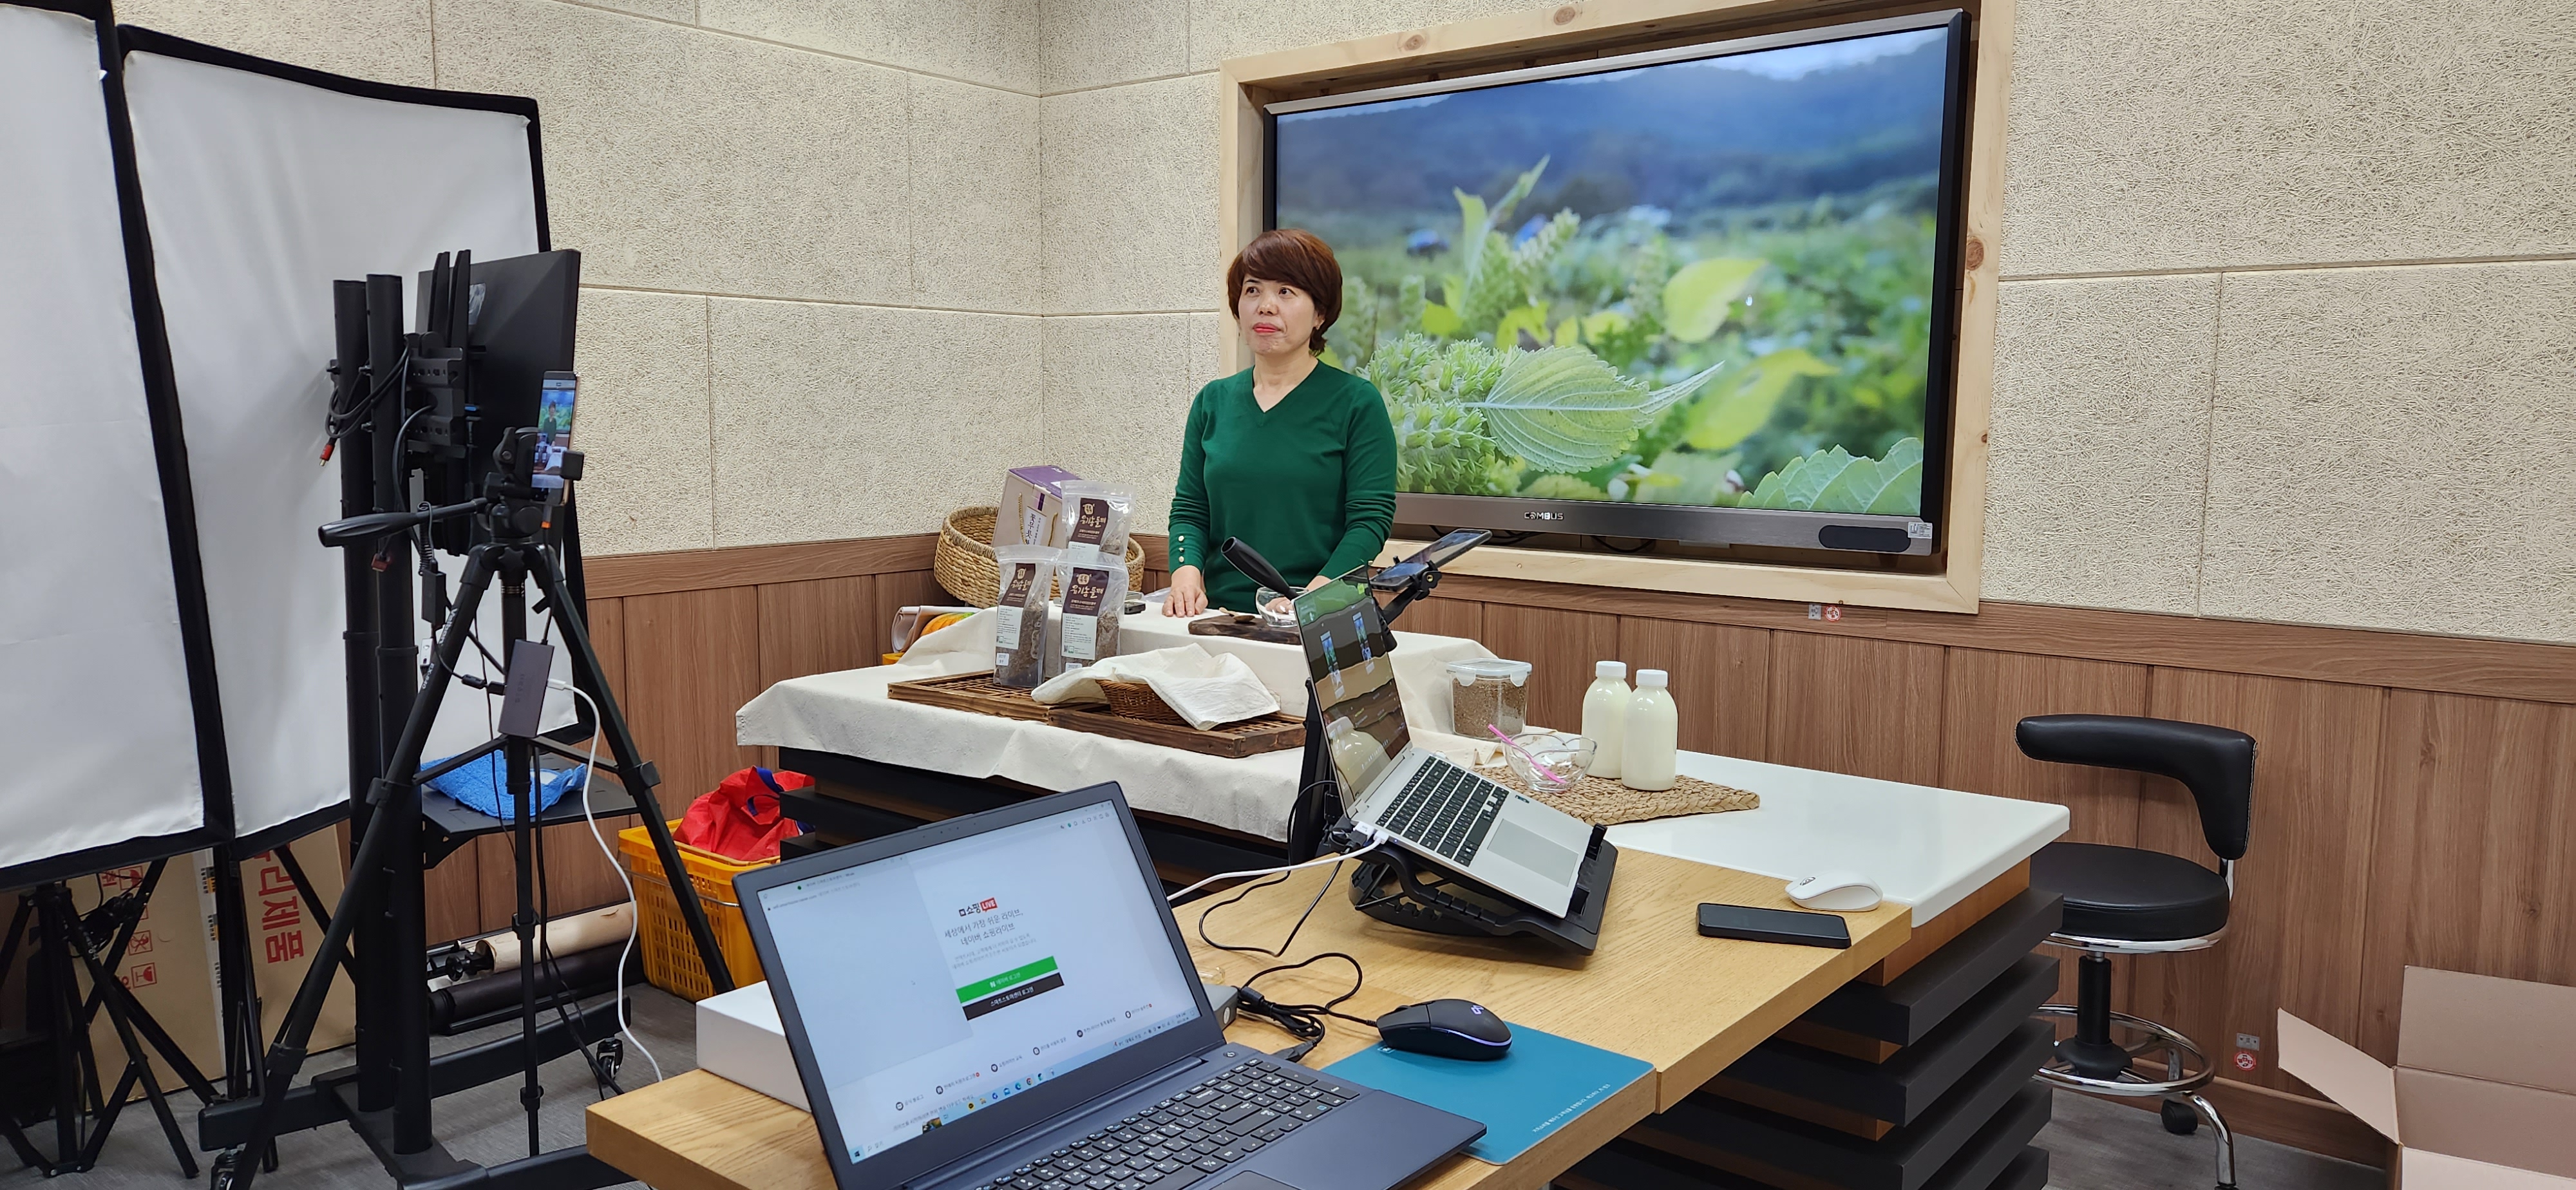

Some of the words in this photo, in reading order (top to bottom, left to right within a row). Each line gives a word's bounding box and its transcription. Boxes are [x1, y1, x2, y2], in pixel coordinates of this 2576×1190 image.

[439, 608, 458, 645] Velbon
[967, 903, 981, 914] 쇼핑
[981, 900, 996, 911] LIVE
